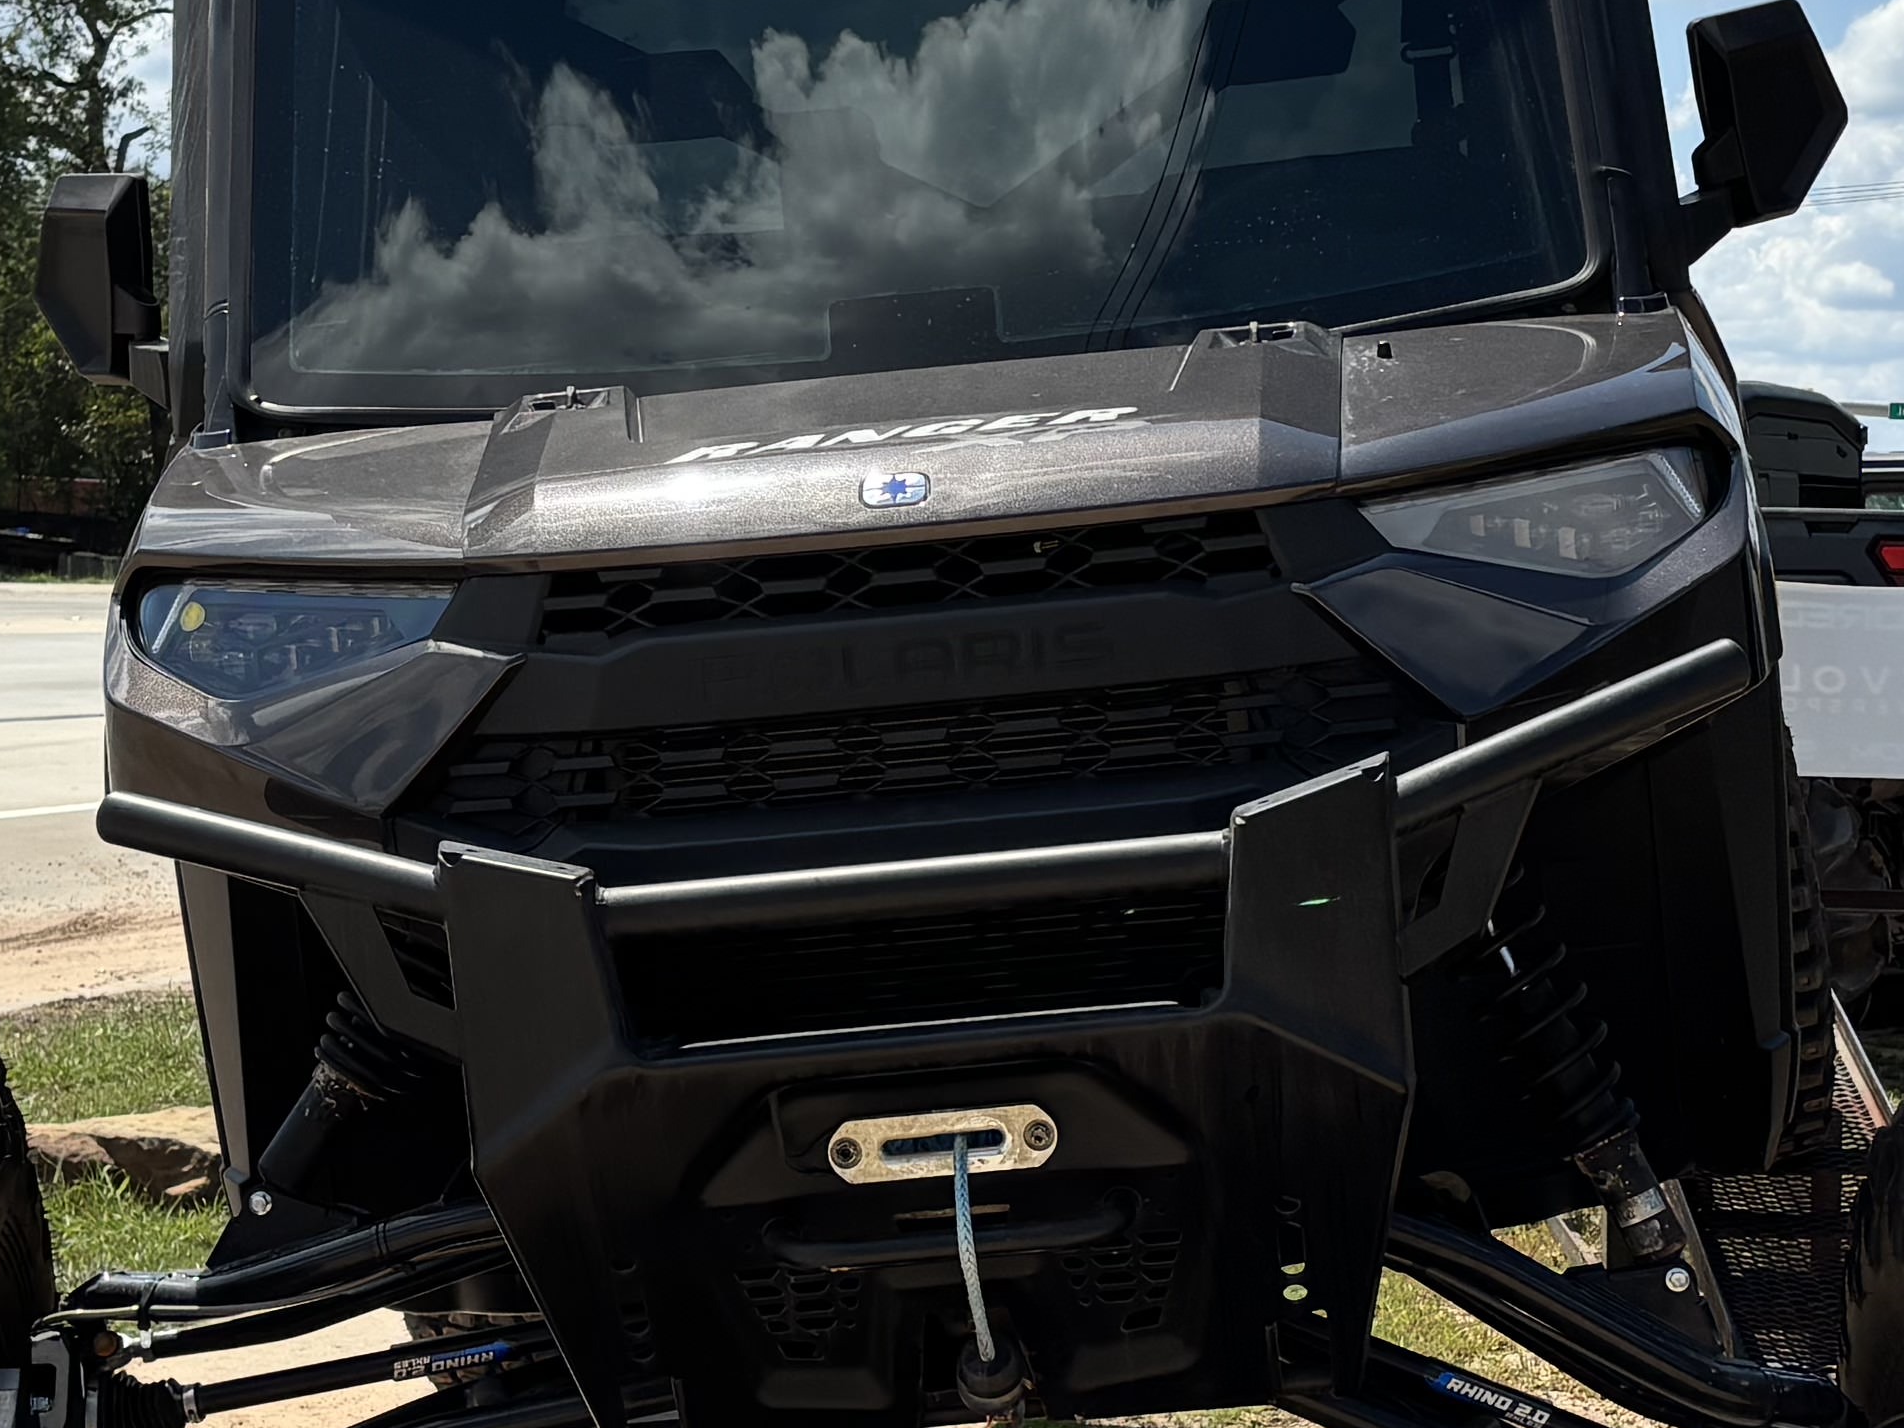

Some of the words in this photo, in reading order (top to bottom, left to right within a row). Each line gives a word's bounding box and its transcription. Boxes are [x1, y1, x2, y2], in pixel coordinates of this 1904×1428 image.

[663, 406, 1139, 465] RANGER
[393, 1364, 426, 1380] 2.0
[431, 1350, 494, 1373] RHINO
[1446, 1377, 1513, 1411] RHINO
[1513, 1401, 1551, 1425] 2.0
